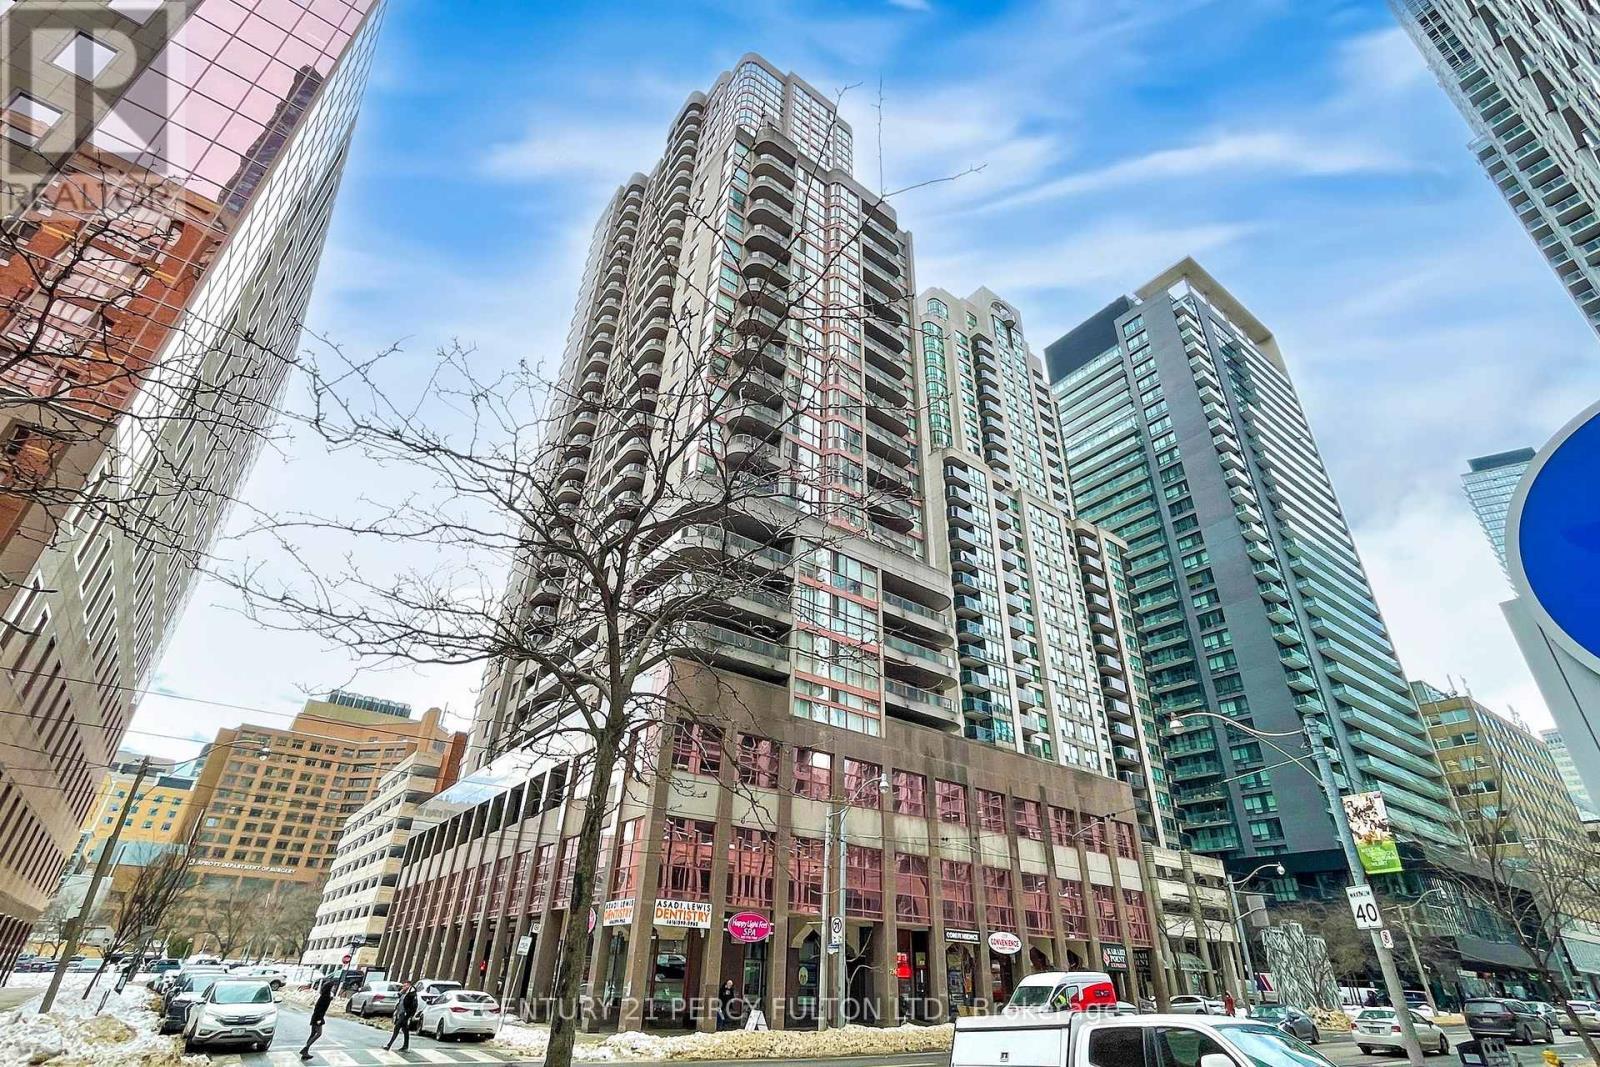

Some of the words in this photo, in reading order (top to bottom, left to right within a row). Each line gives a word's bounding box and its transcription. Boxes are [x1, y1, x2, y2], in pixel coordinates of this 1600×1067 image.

[222, 862, 261, 871] DEPARTMENT
[655, 908, 710, 923] DENTISTRY
[1357, 903, 1377, 922] 40
[743, 928, 756, 936] SPA
[991, 938, 1020, 948] CONVENIENCE
